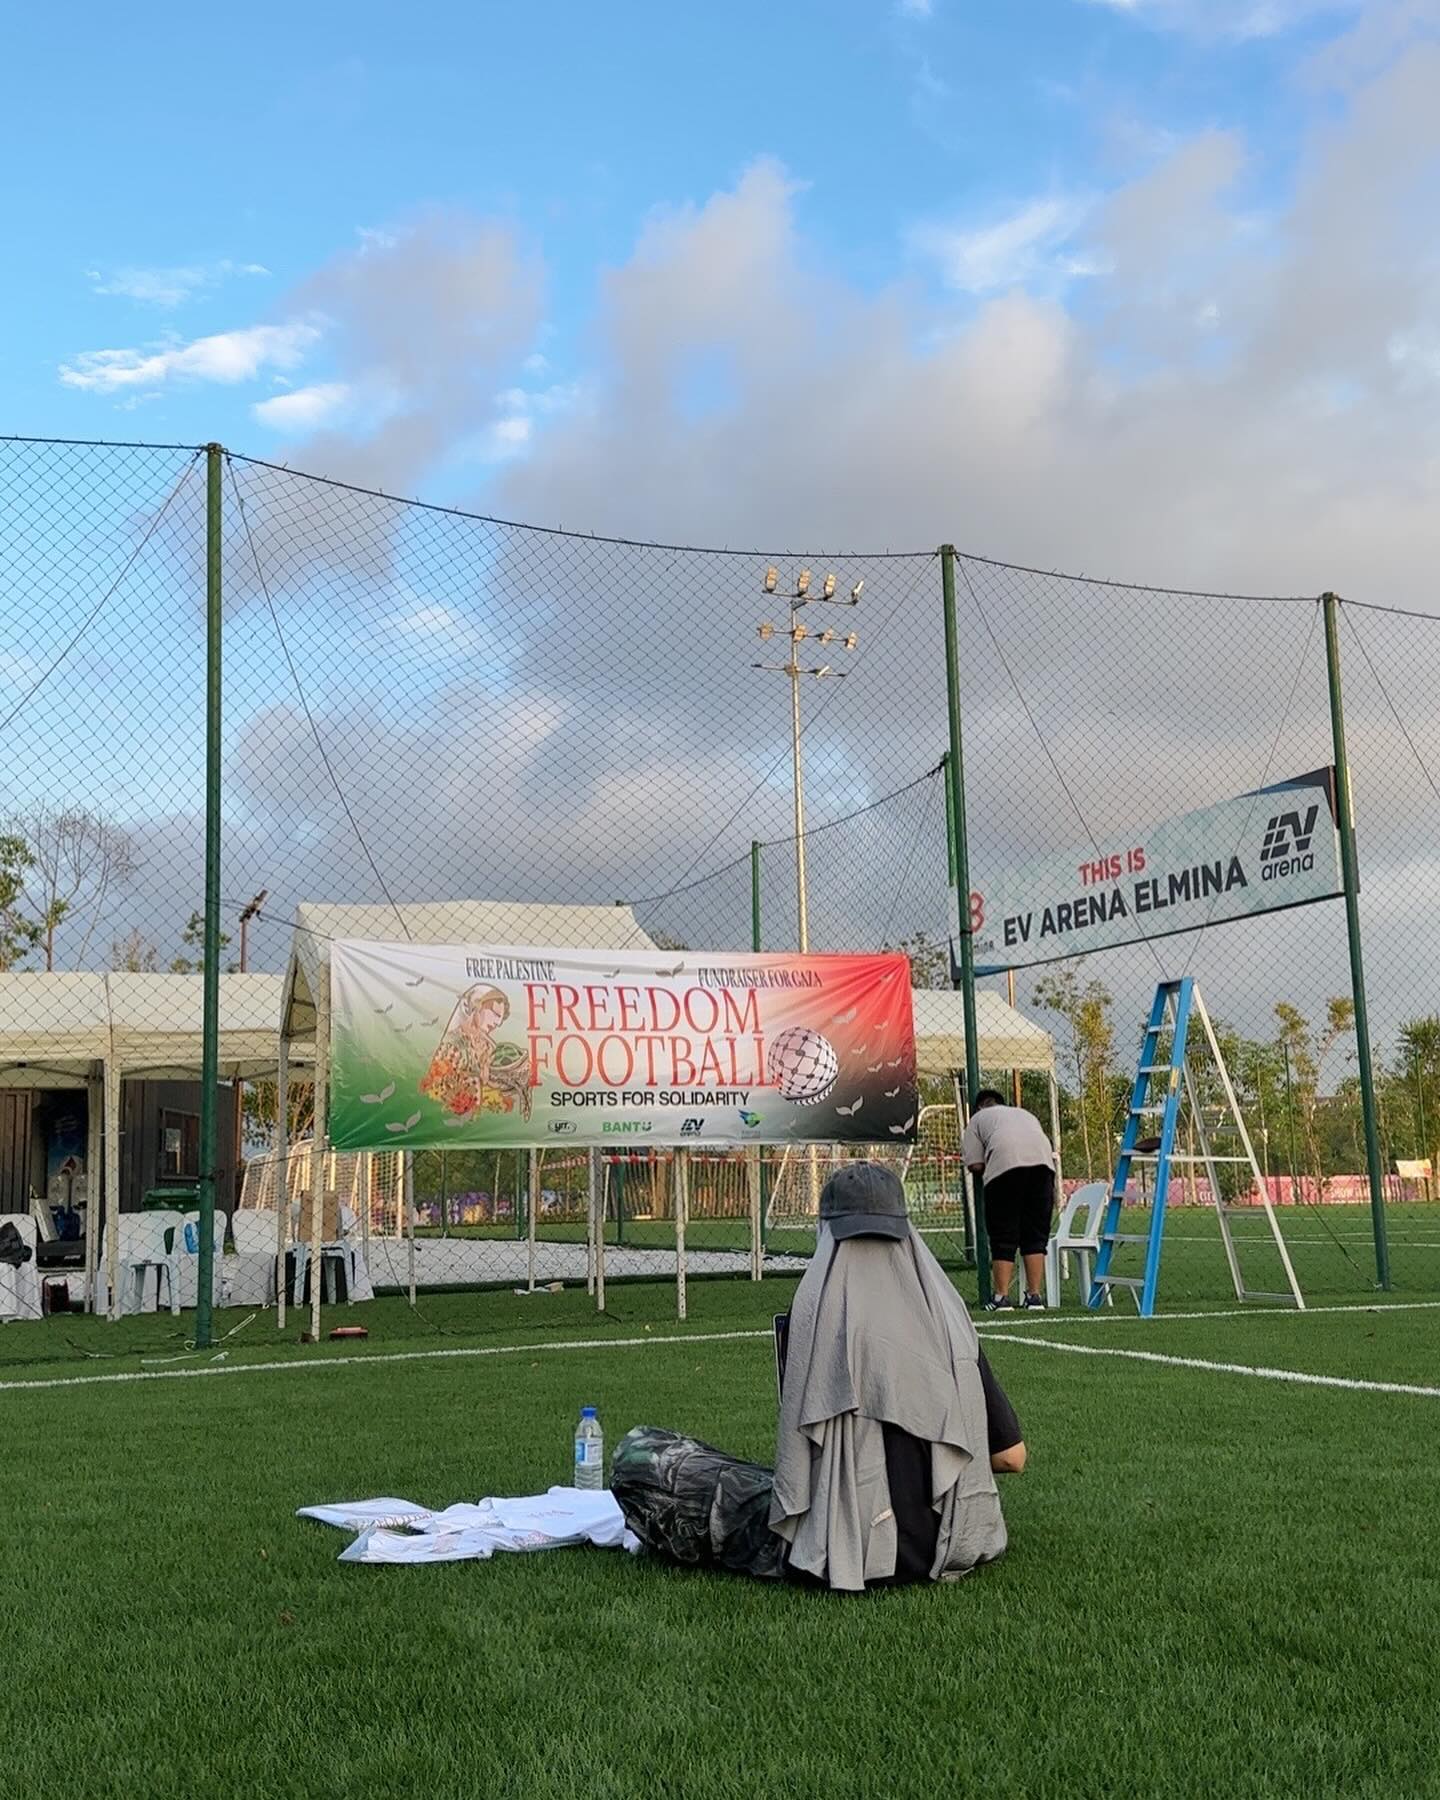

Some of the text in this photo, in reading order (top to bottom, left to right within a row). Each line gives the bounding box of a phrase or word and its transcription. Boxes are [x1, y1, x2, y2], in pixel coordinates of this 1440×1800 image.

[1079, 847, 1145, 886] THIS IS
[1261, 852, 1314, 881] arena
[1003, 856, 1249, 947] EV ARENA ELMINA
[466, 957, 556, 982] FREE PALESTINE
[698, 968, 823, 988] FUNDRAISER FOR GAZA
[523, 983, 763, 1034] FREEDOM
[527, 1033, 782, 1088] FOOTBALL
[550, 1091, 750, 1107] SPORTS FOR SOLIDARITY
